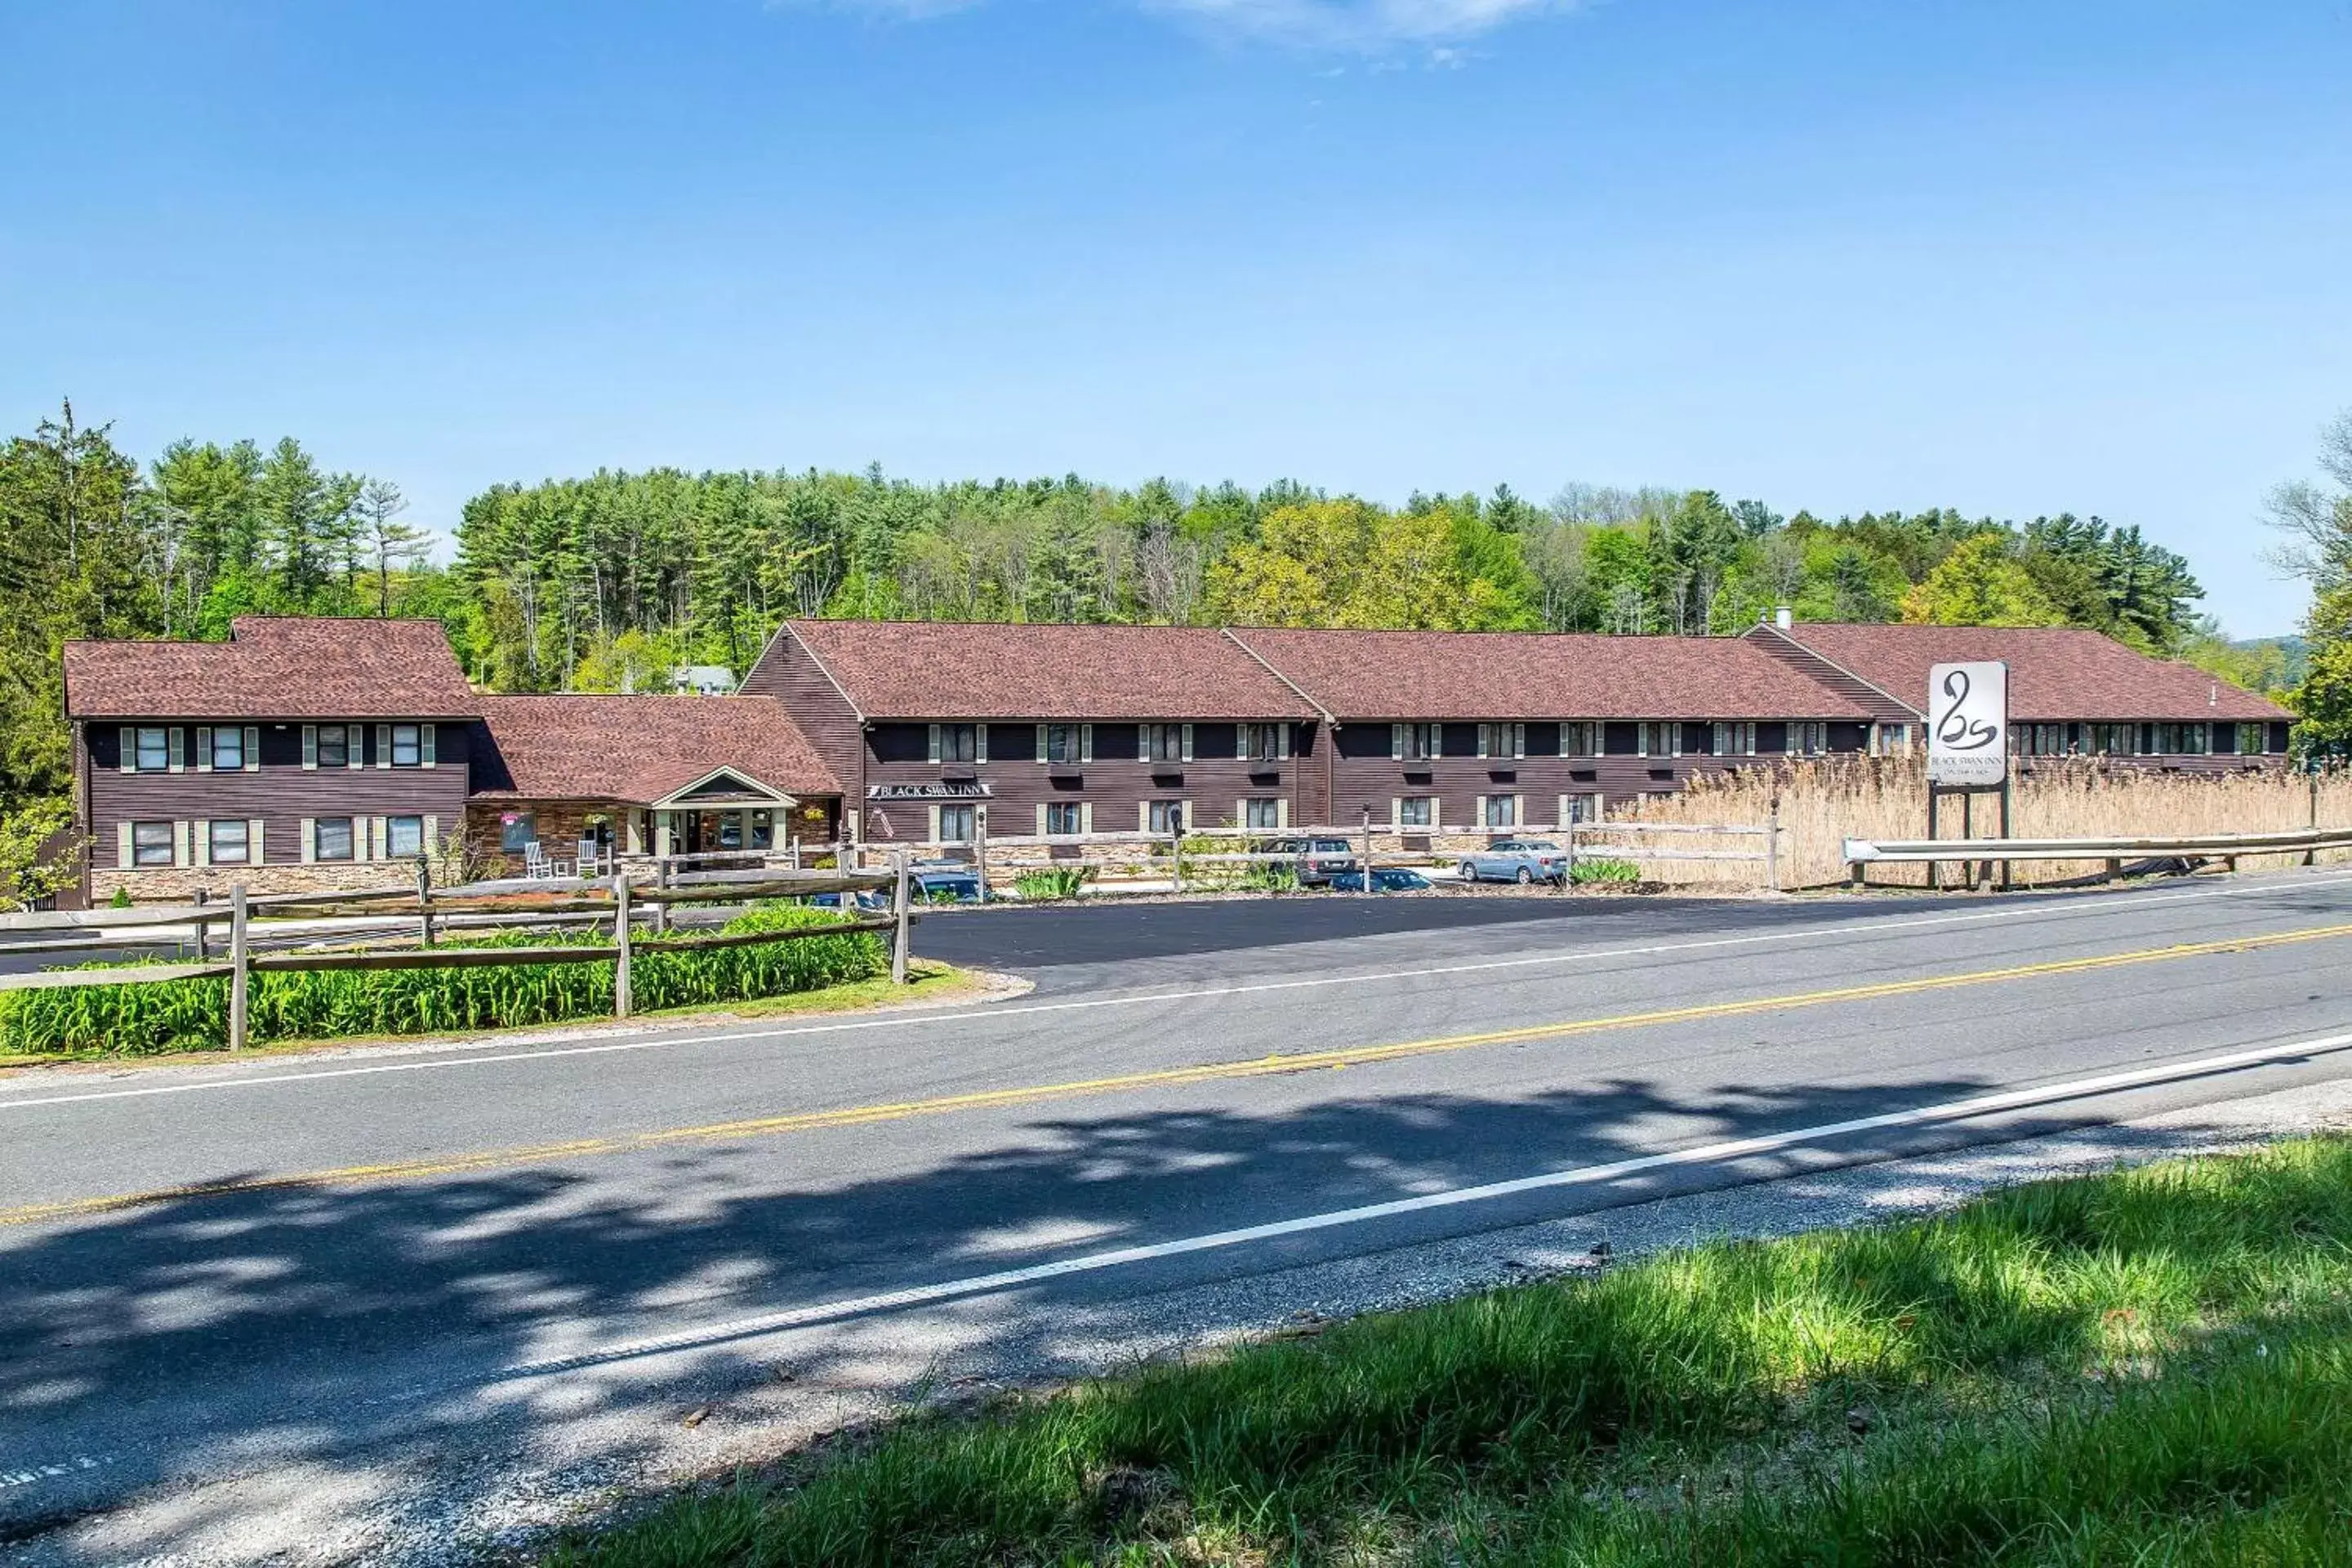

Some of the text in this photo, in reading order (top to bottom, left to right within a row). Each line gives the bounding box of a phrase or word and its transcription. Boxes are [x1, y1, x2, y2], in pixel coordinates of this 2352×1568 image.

[880, 784, 980, 797] BLACK SWAN INN
